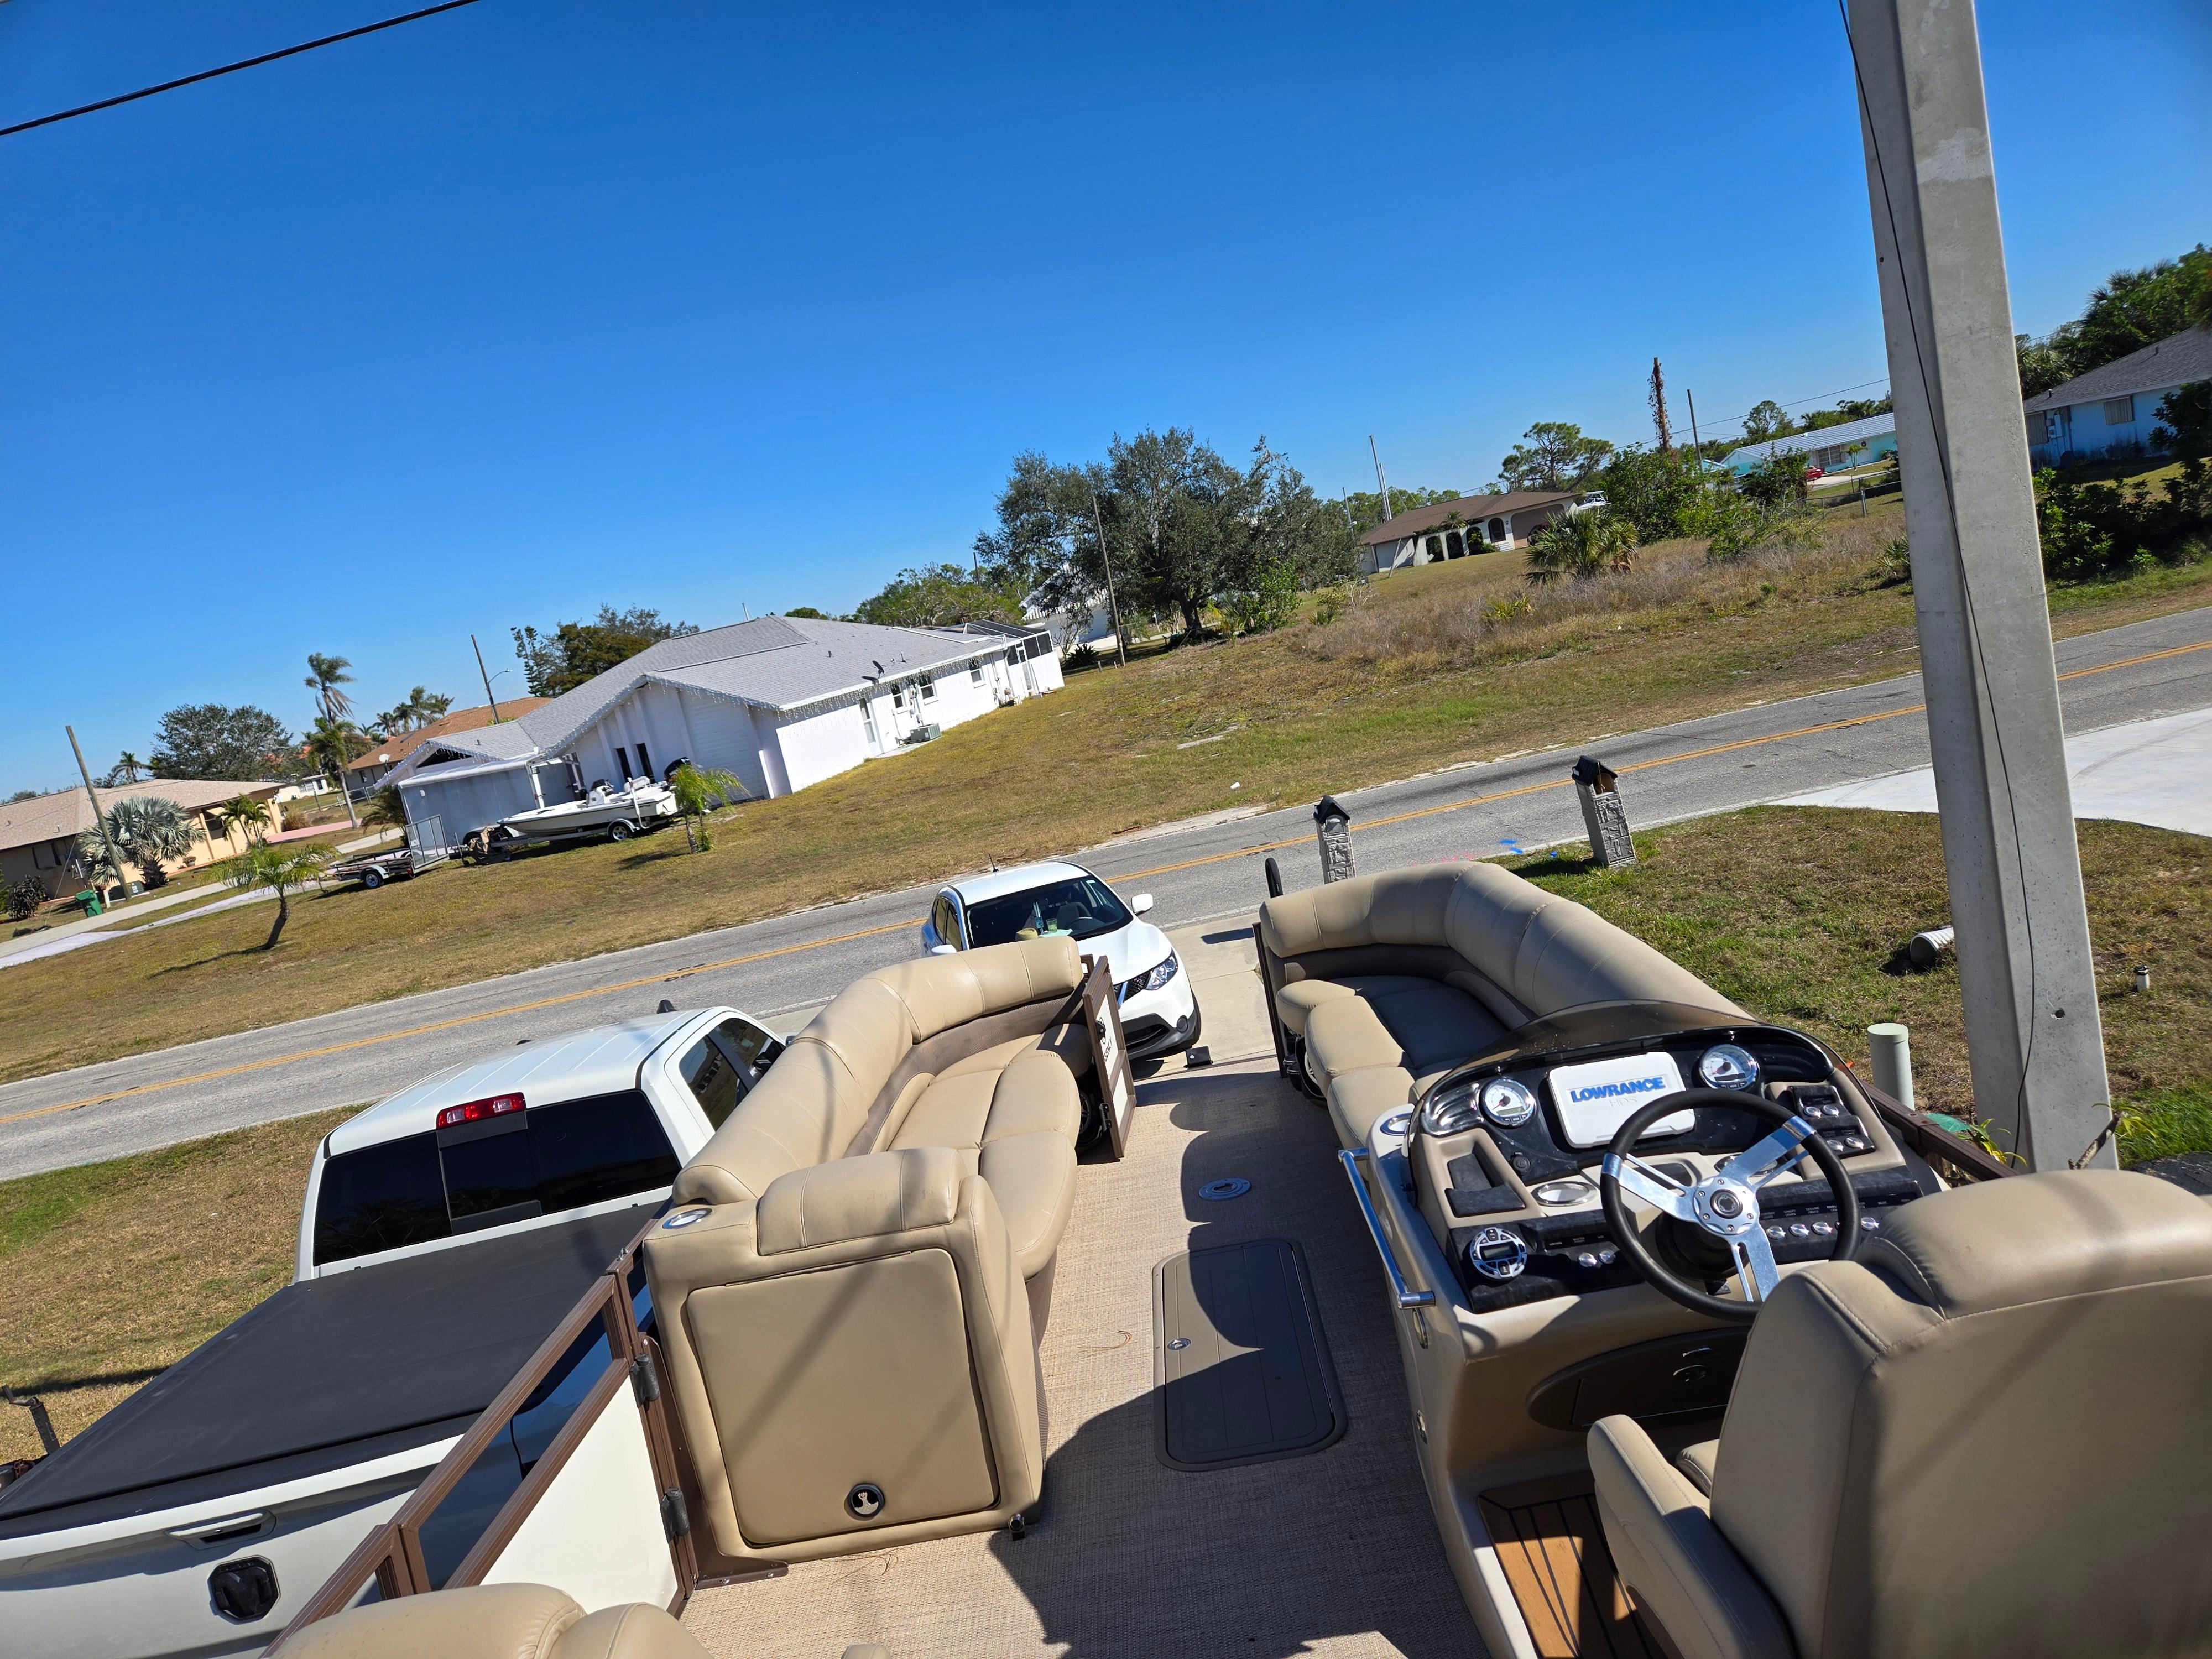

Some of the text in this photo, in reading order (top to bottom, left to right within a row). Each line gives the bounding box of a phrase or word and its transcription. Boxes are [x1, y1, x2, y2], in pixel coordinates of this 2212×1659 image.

[1103, 1036, 1112, 1062] GENCY
[1570, 1076, 1666, 1103] LOWRANCE
[1609, 1096, 1637, 1107] HDS
